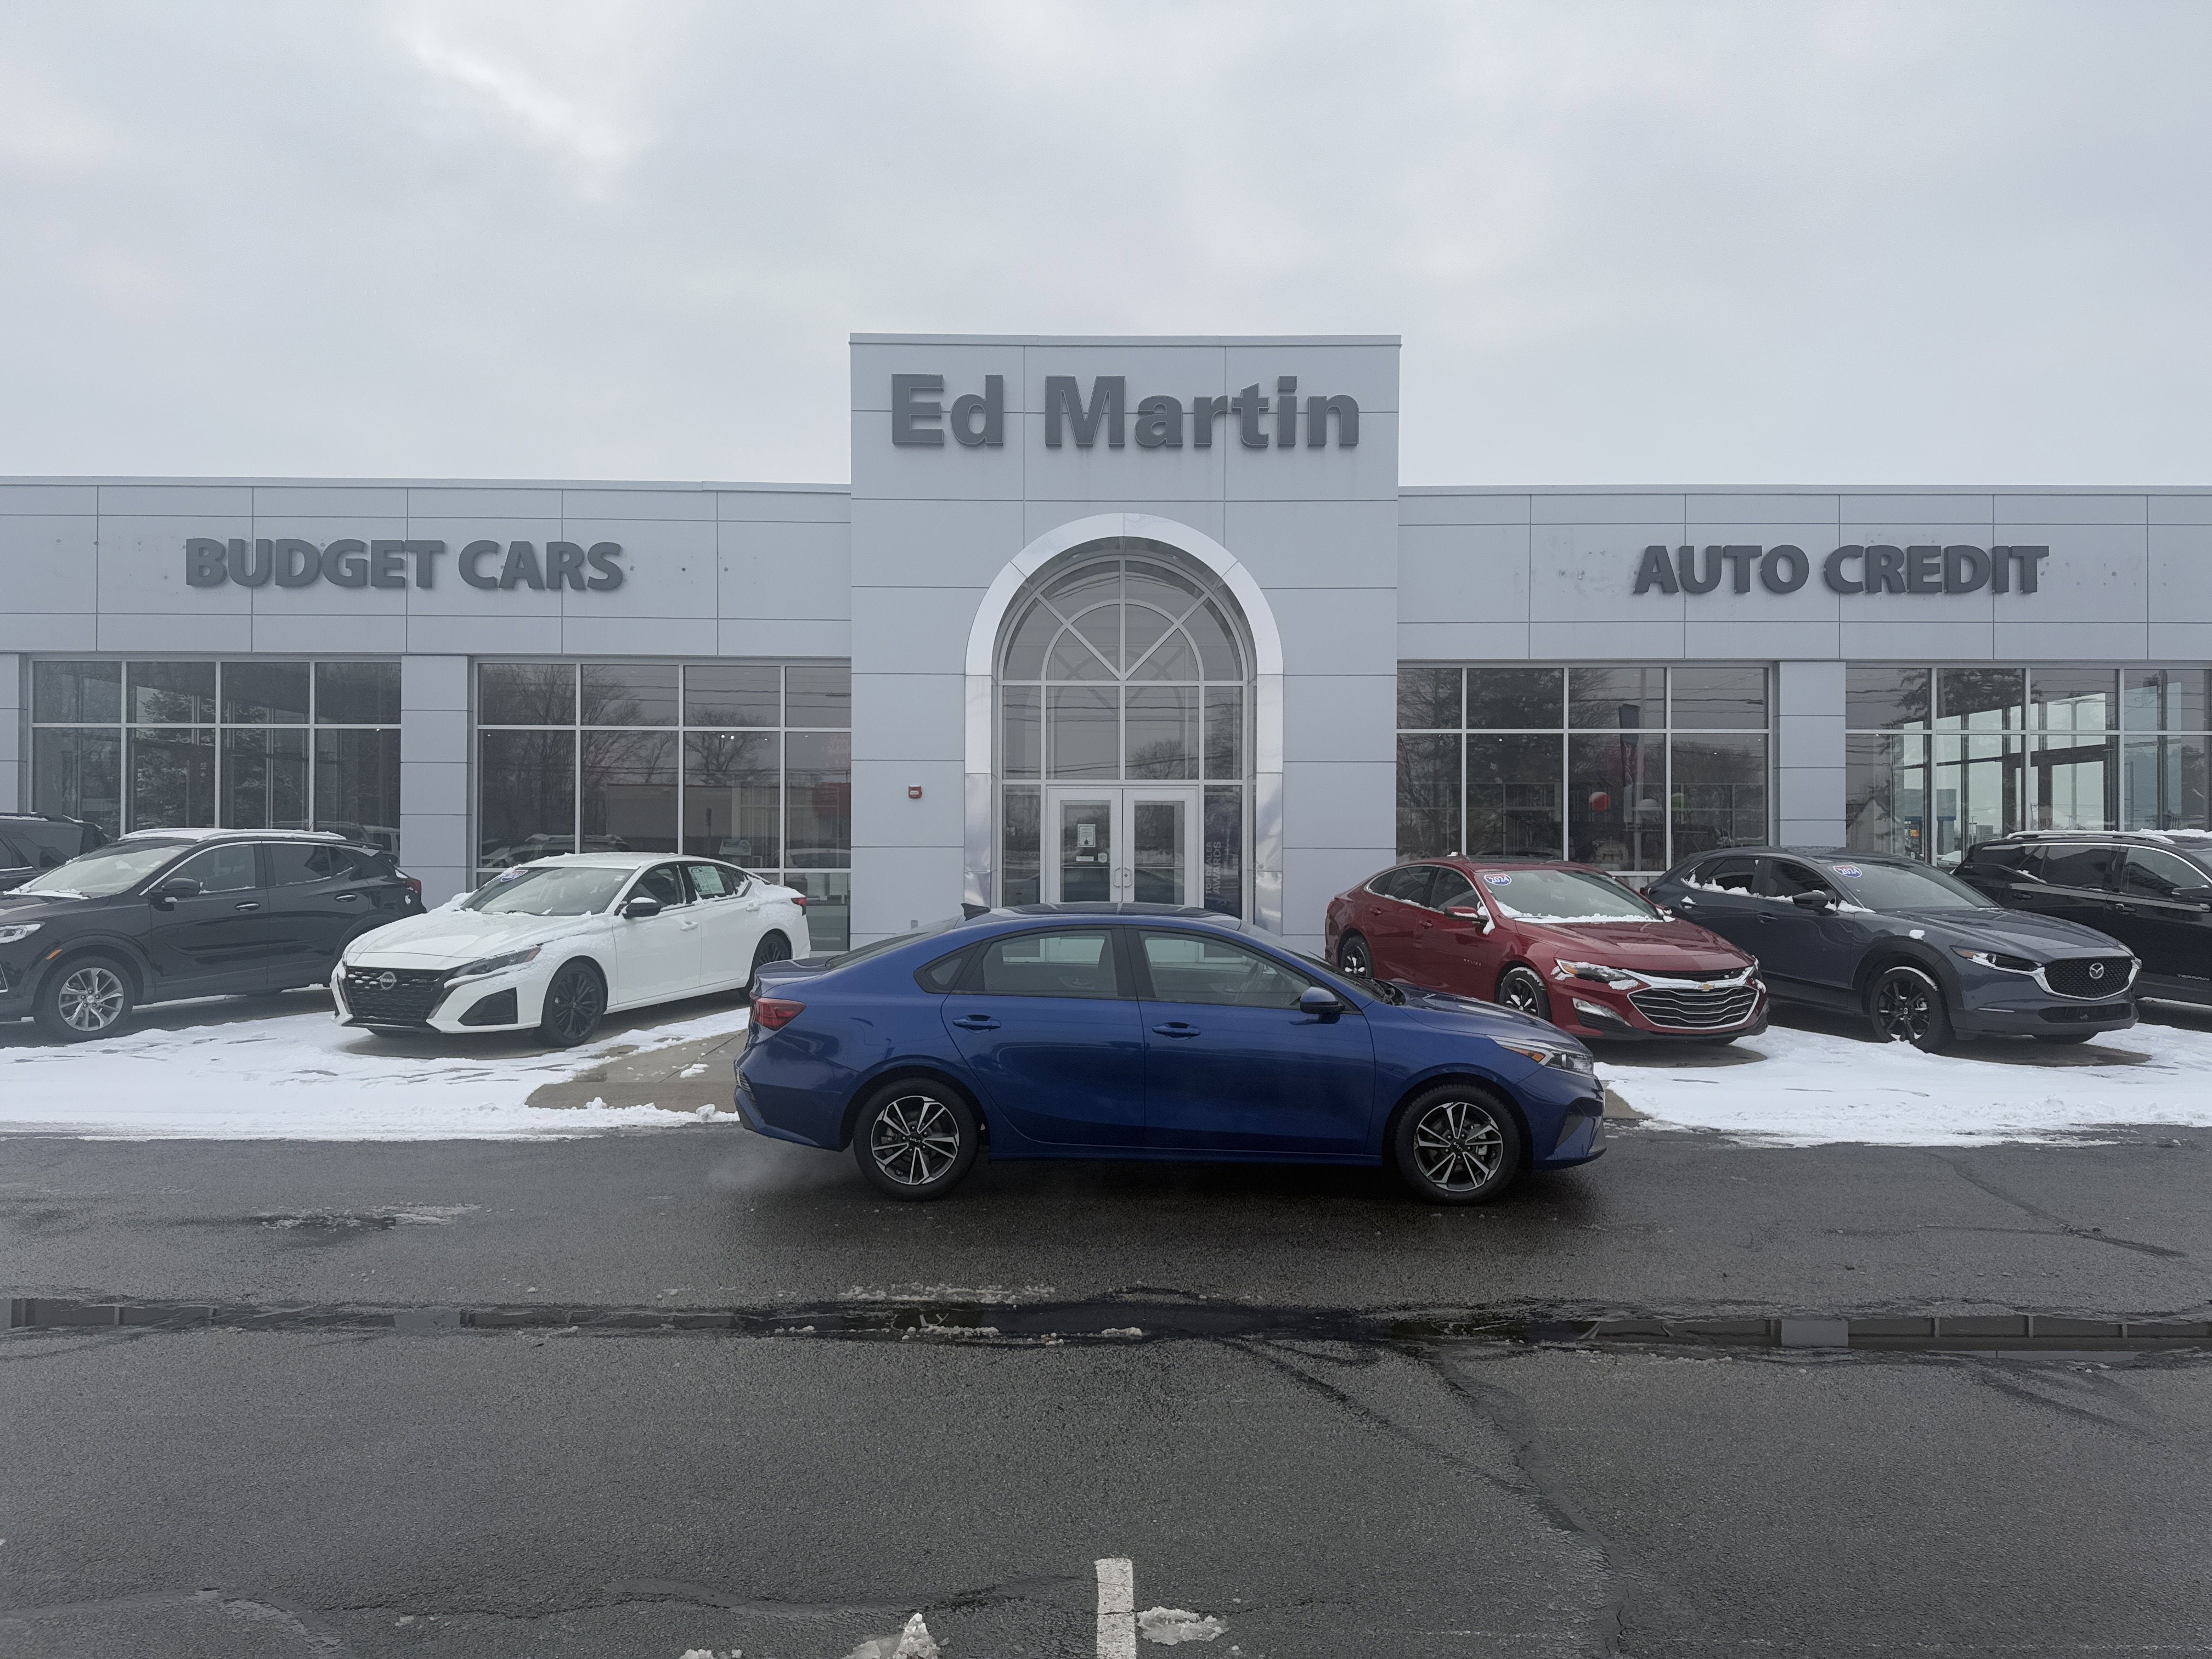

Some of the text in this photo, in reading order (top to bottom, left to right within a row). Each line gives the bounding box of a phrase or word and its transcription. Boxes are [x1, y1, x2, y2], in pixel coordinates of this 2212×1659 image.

[891, 374, 1359, 448] Ed Martin
[185, 538, 624, 590] BUDGET CARS
[1633, 545, 2049, 595] AUTO CREDIT
